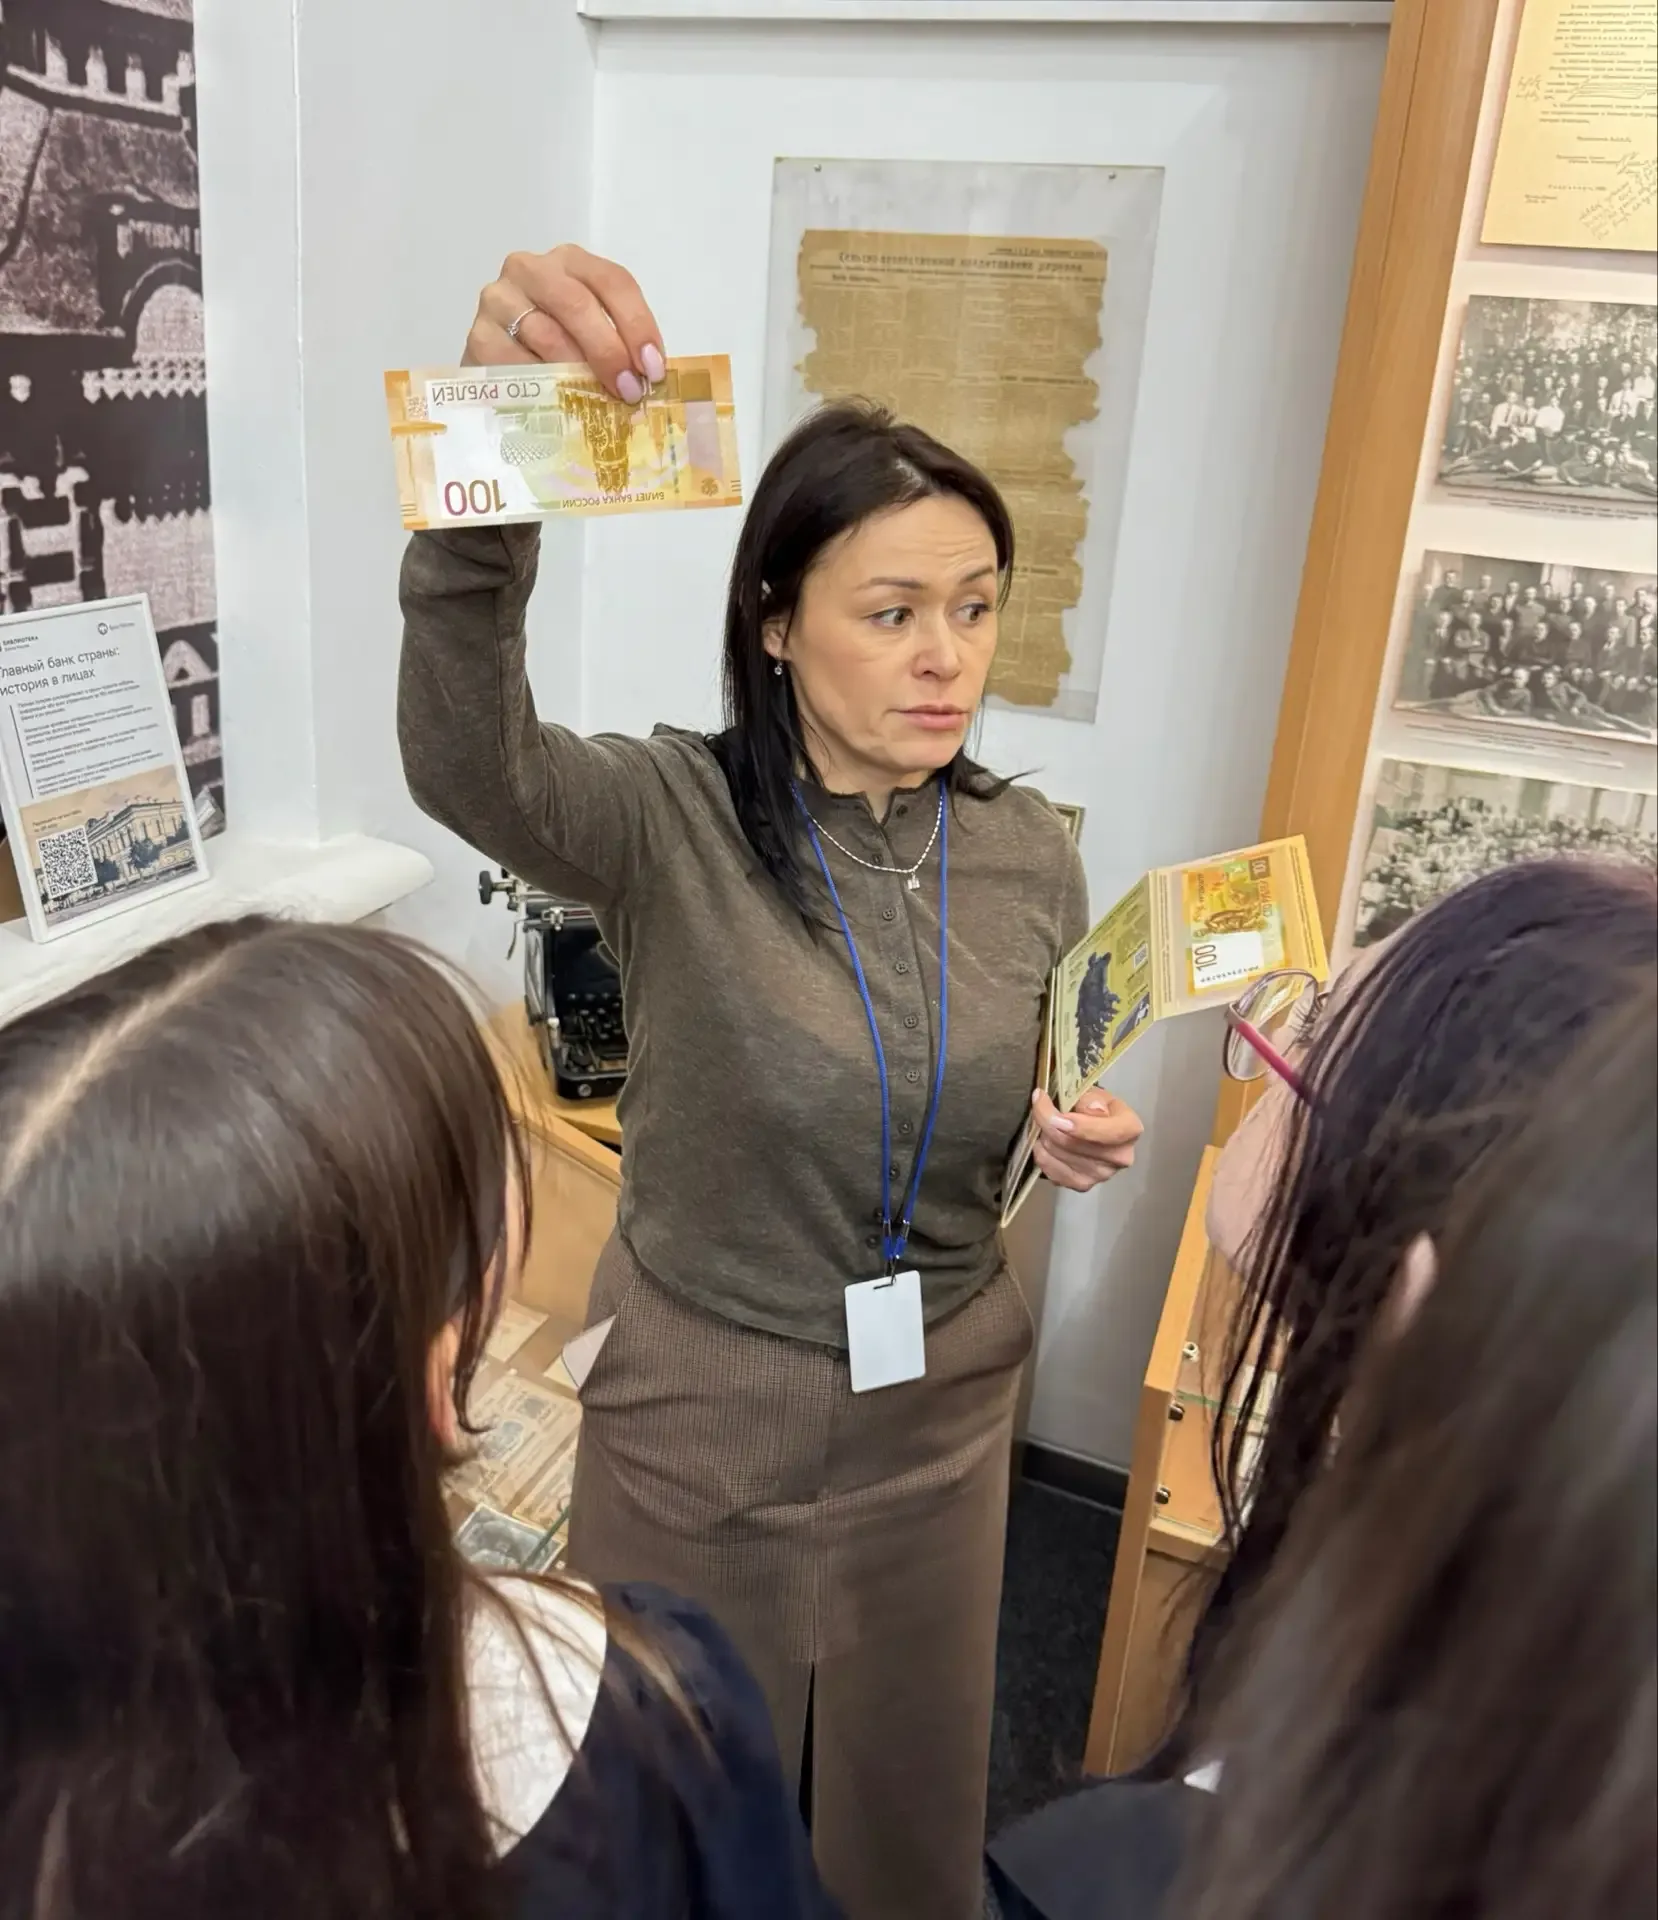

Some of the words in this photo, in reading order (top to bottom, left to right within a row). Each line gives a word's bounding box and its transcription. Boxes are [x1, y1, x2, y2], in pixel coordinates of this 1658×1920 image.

[432, 383, 499, 406] РУБЛЕЙ
[506, 382, 541, 399] СТО
[444, 479, 507, 516] 100
[561, 497, 600, 509] РОССИИ
[602, 494, 632, 505] БАНКА
[635, 490, 665, 502] БИЛЕТ
[0, 659, 45, 679] лавный
[47, 655, 76, 669] банк
[78, 646, 120, 664] страны:
[0, 678, 49, 697] история
[51, 675, 59, 686] в
[62, 668, 96, 684] лицах
[1194, 944, 1218, 972] 100
